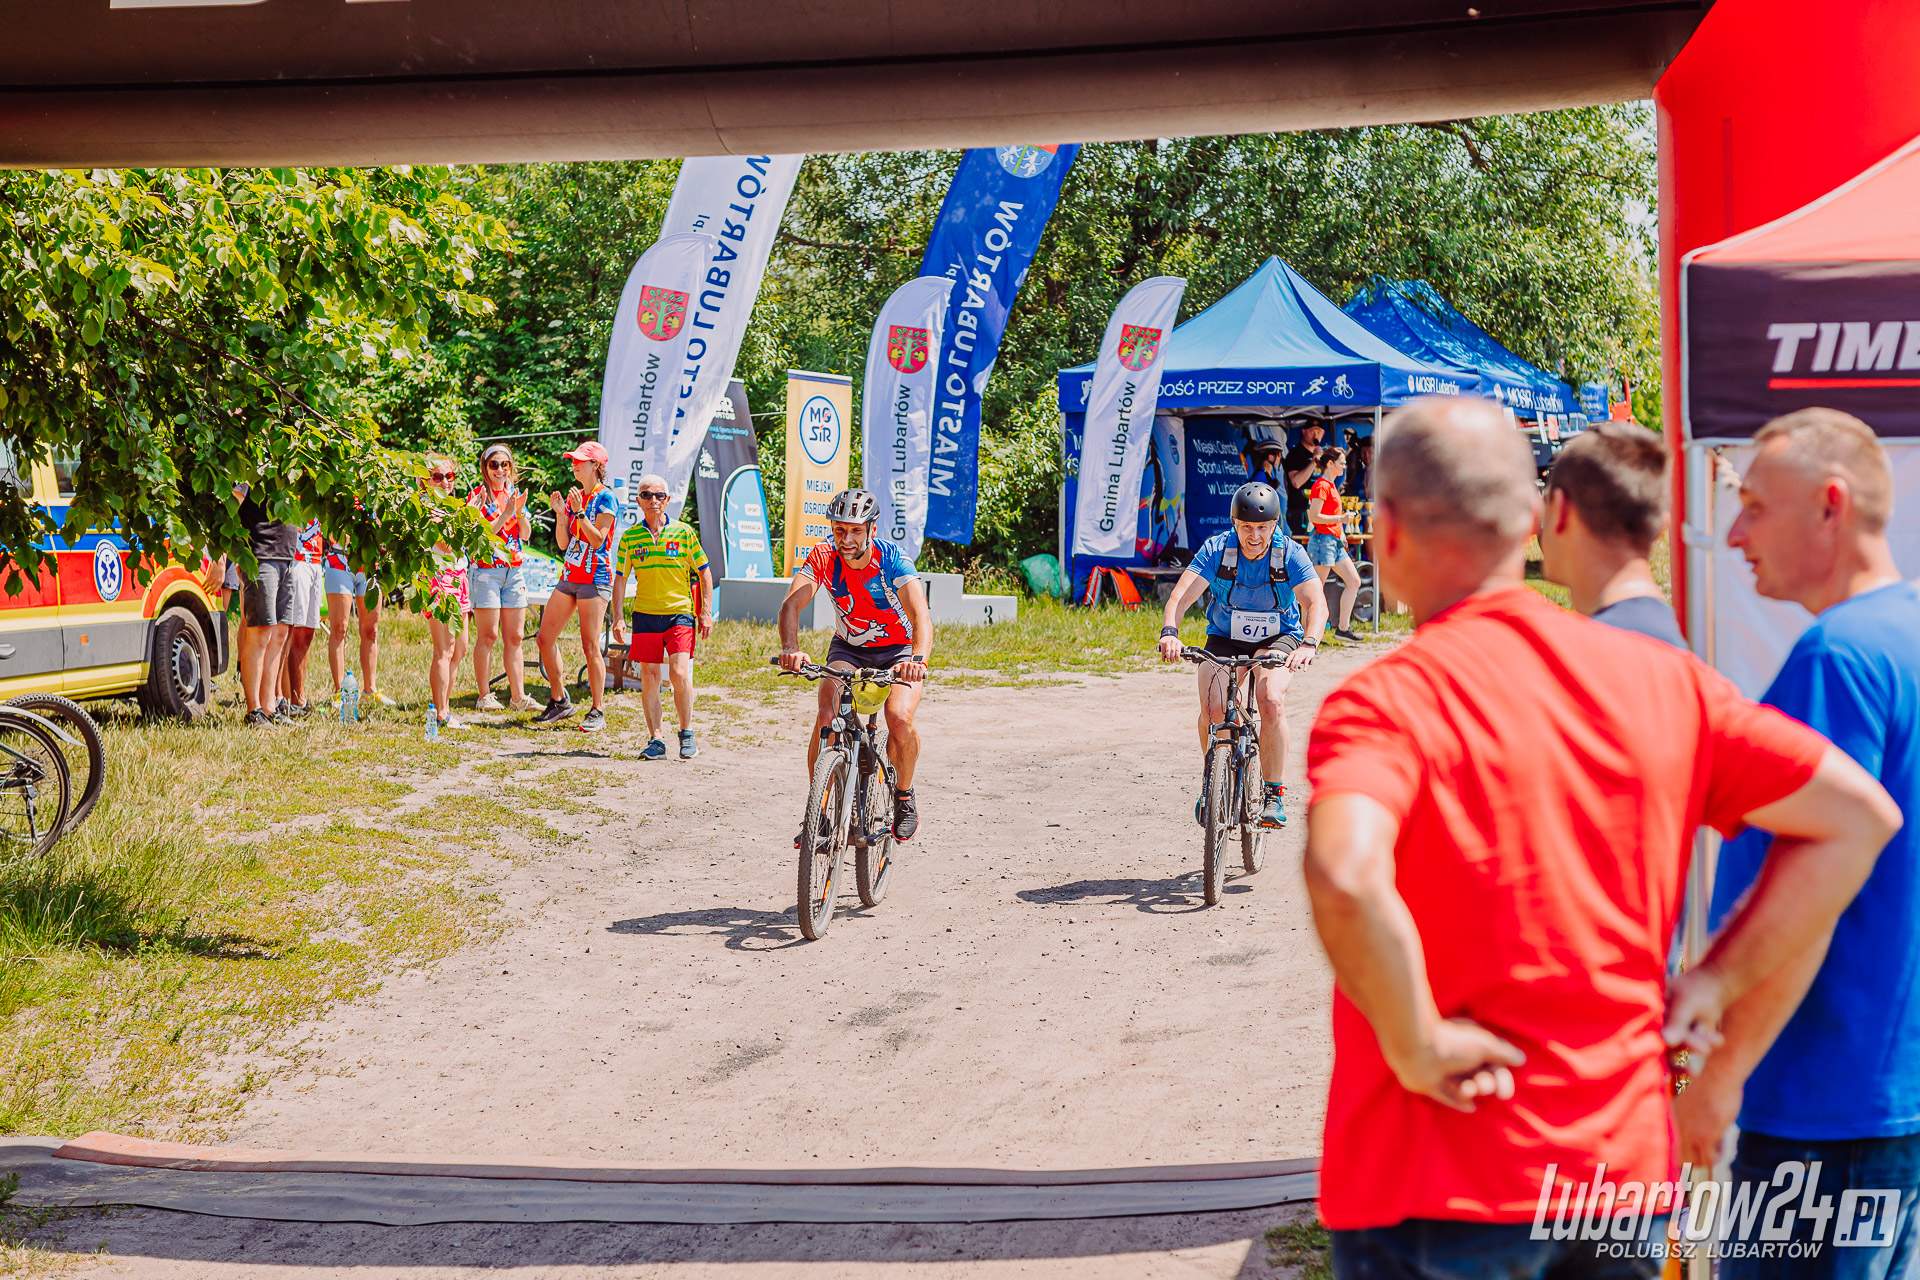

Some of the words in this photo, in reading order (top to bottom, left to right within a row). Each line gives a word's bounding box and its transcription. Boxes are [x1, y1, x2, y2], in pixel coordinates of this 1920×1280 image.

[629, 353, 661, 451] Lubartów
[1198, 381, 1243, 395] PRZEZ
[1246, 381, 1295, 395] SPORT
[892, 384, 912, 473] Lubartów
[1099, 474, 1121, 532] Gmina
[1112, 380, 1137, 467] Lubartów
[806, 479, 834, 493] MIEJSKI
[891, 478, 907, 541] Gmina
[1242, 624, 1269, 638] 6/1
